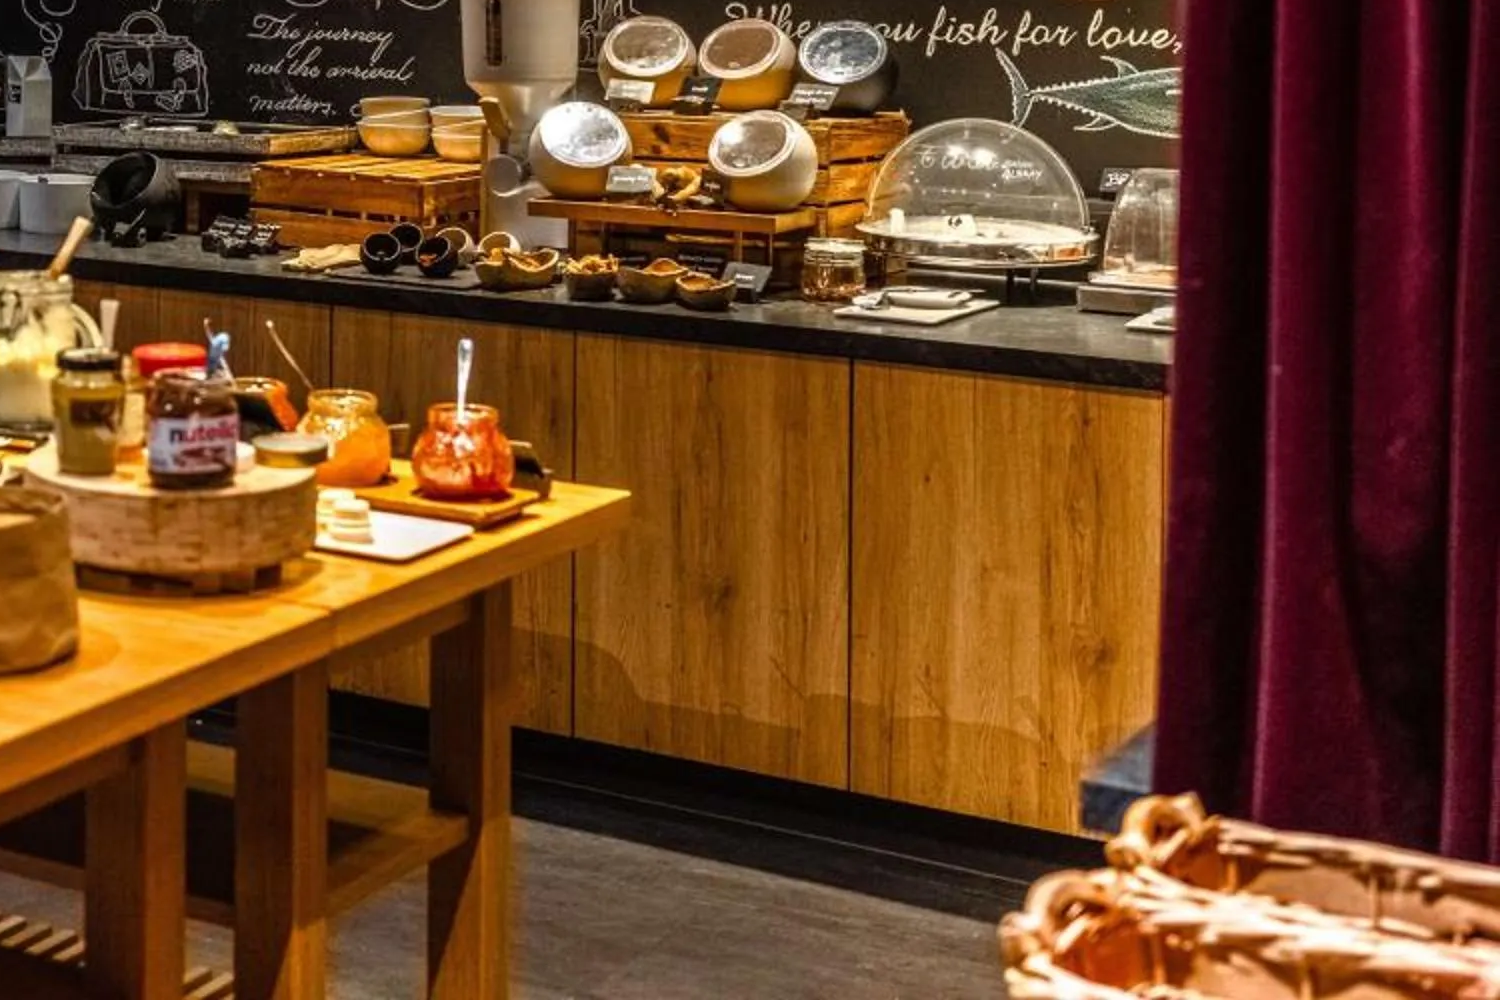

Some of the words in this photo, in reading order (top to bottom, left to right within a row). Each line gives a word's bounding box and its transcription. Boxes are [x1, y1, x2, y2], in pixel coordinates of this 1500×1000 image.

[246, 12, 300, 40] The
[286, 20, 393, 64] journey
[927, 5, 1007, 57] fish
[1008, 9, 1077, 56] for
[1087, 7, 1183, 53] love,
[247, 57, 285, 75] not
[287, 45, 322, 79] the
[326, 56, 416, 82] arrival
